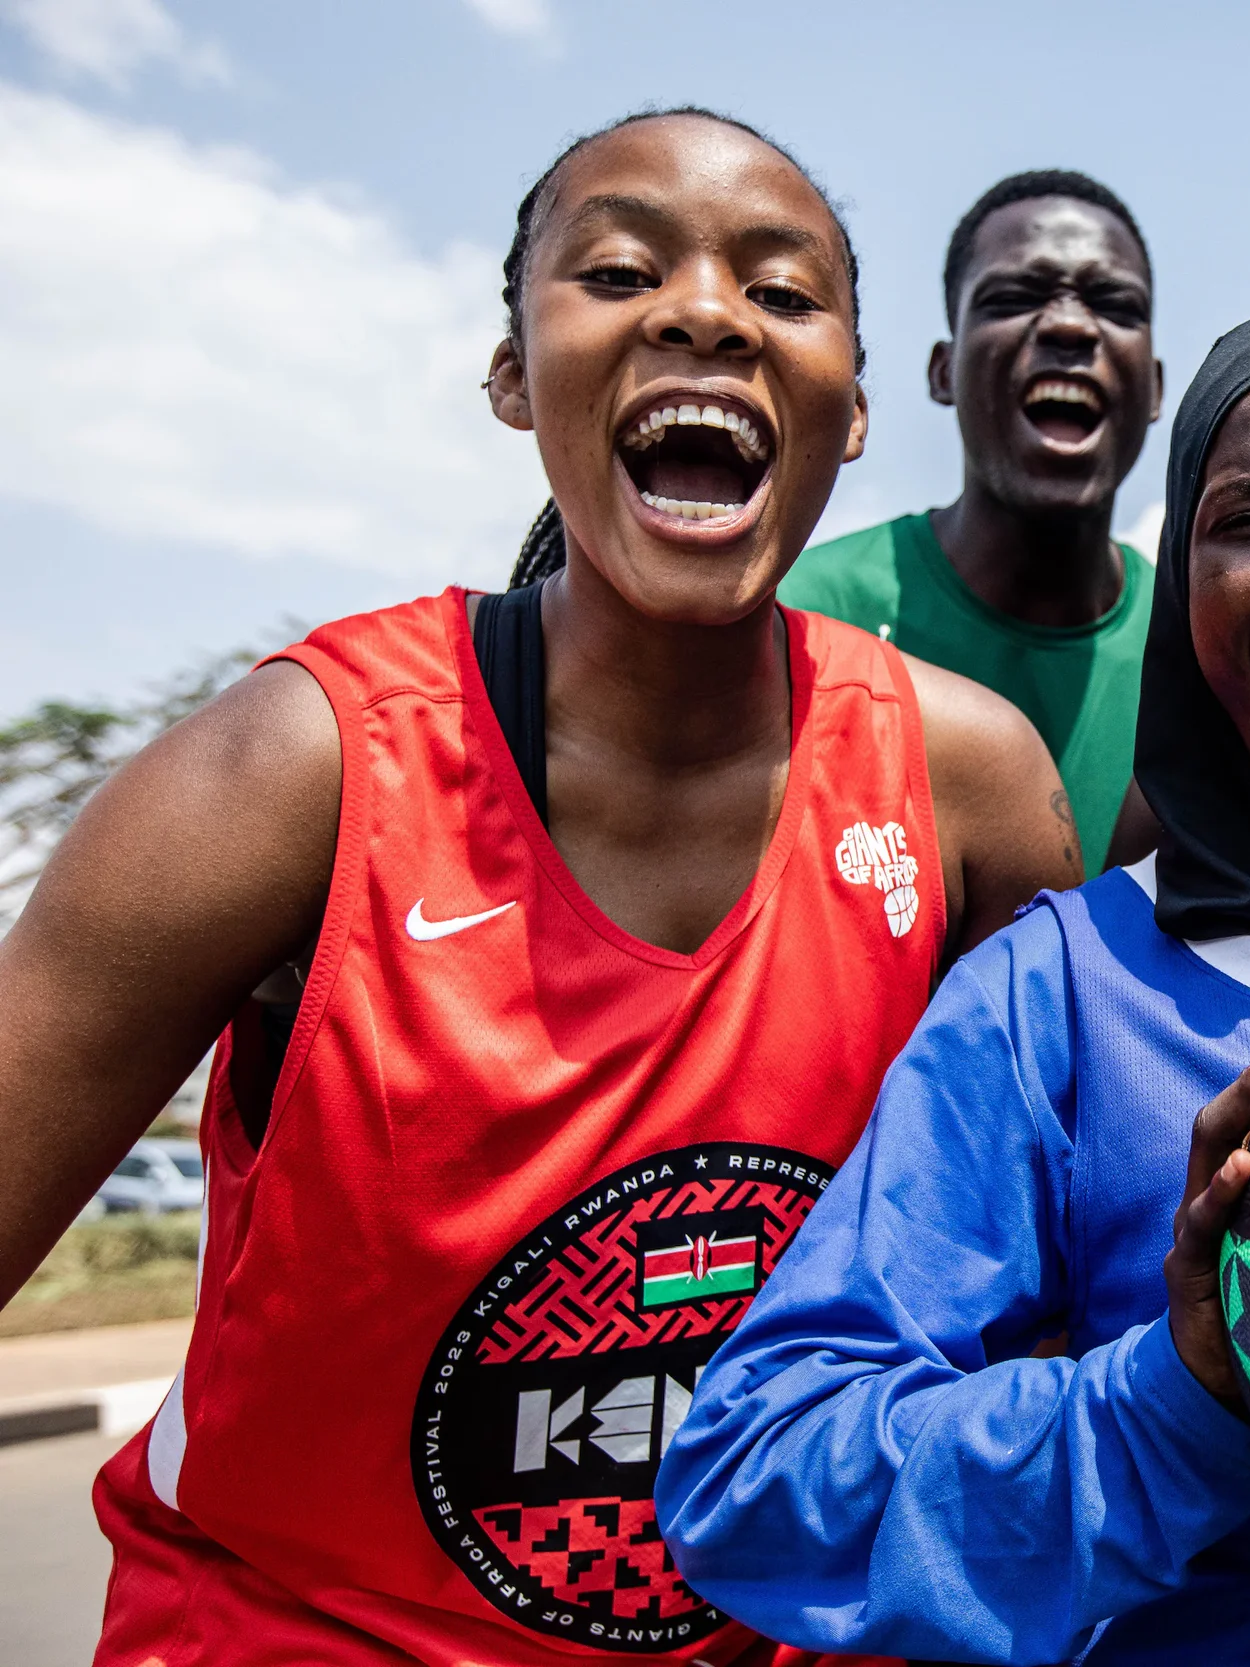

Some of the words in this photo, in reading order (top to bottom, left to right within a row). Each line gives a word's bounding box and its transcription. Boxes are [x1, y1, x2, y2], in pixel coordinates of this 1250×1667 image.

[835, 821, 907, 872] GIANTS
[841, 865, 872, 885] OF
[874, 856, 919, 894] AFRICA
[564, 1164, 674, 1230] RWANDA
[473, 1235, 553, 1318] KIGALI
[434, 1330, 471, 1394] 2023
[426, 1410, 459, 1529] FESTIVAL
[460, 1534, 532, 1607] AFRICA
[541, 1611, 574, 1626] OF
[589, 1622, 691, 1642] GIANTS
